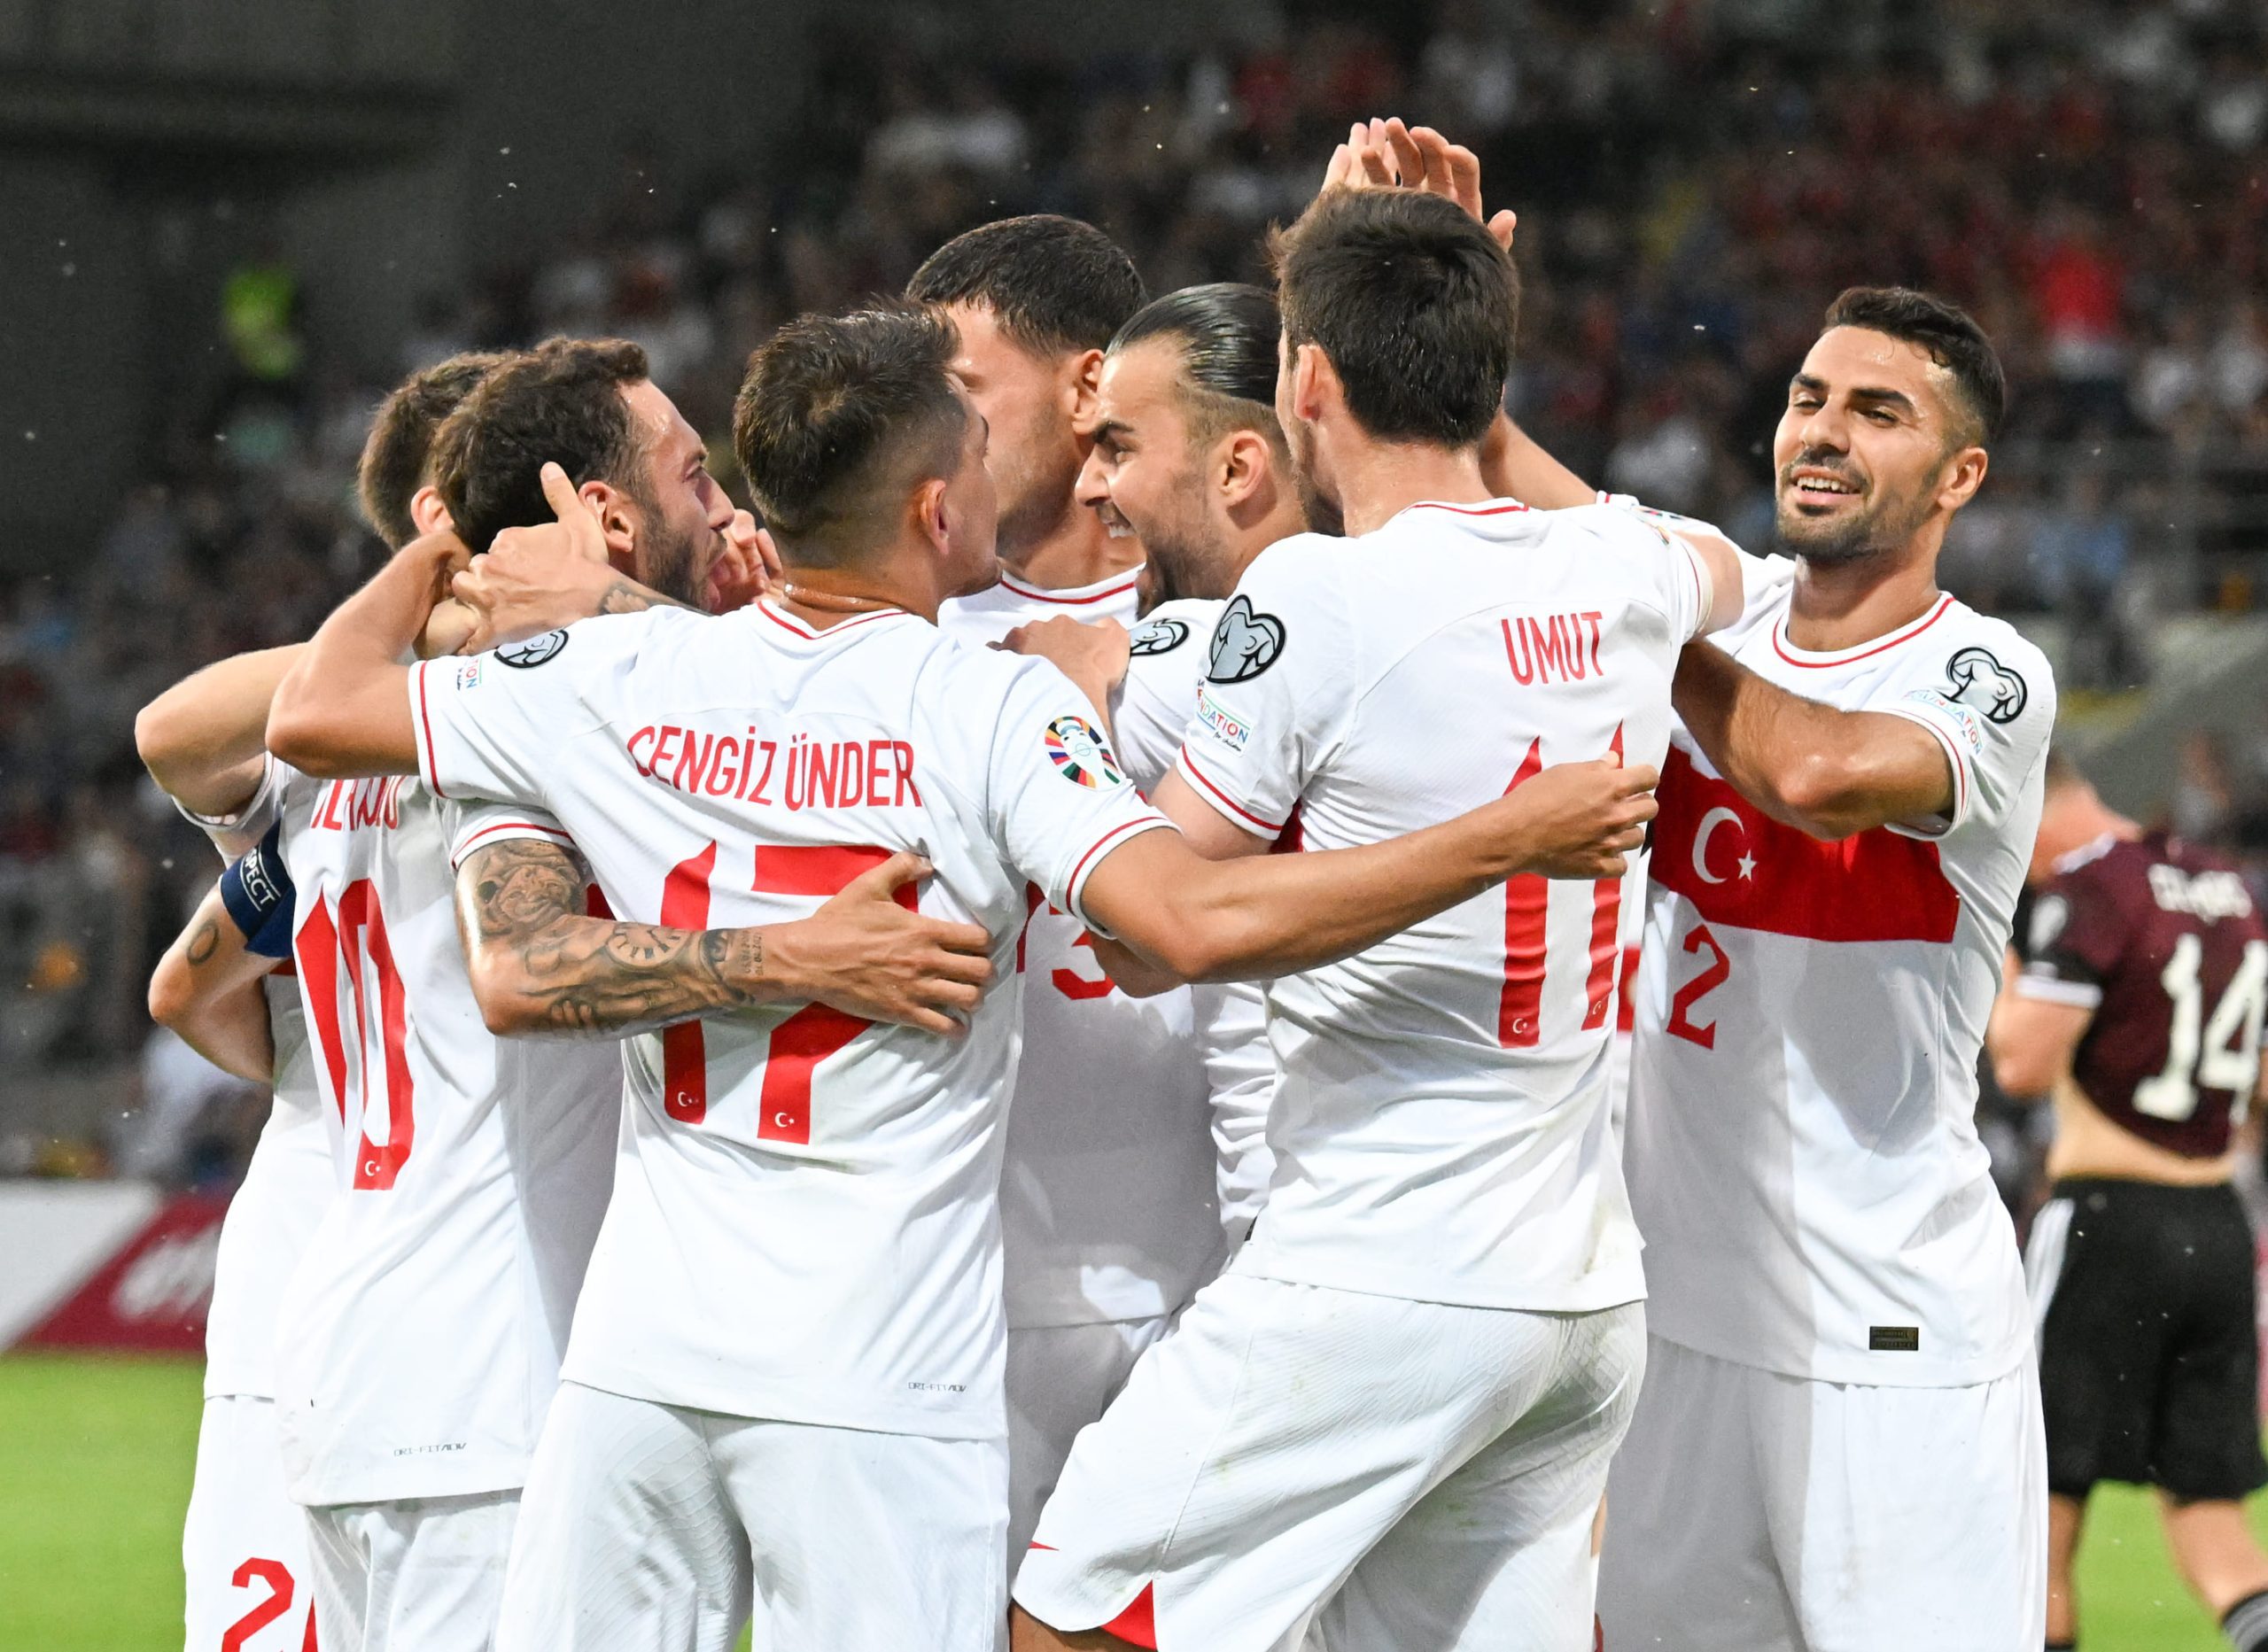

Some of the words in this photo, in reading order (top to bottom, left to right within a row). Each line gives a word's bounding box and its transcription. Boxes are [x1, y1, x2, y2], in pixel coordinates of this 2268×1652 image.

[1501, 610, 1604, 686] UMUT
[626, 725, 777, 806] CENGİZ
[784, 733, 922, 811] ÜNDER
[295, 881, 415, 1191] 10
[660, 838, 920, 1145] 17
[1666, 923, 1730, 1050] 2
[2132, 933, 2268, 1125] 14
